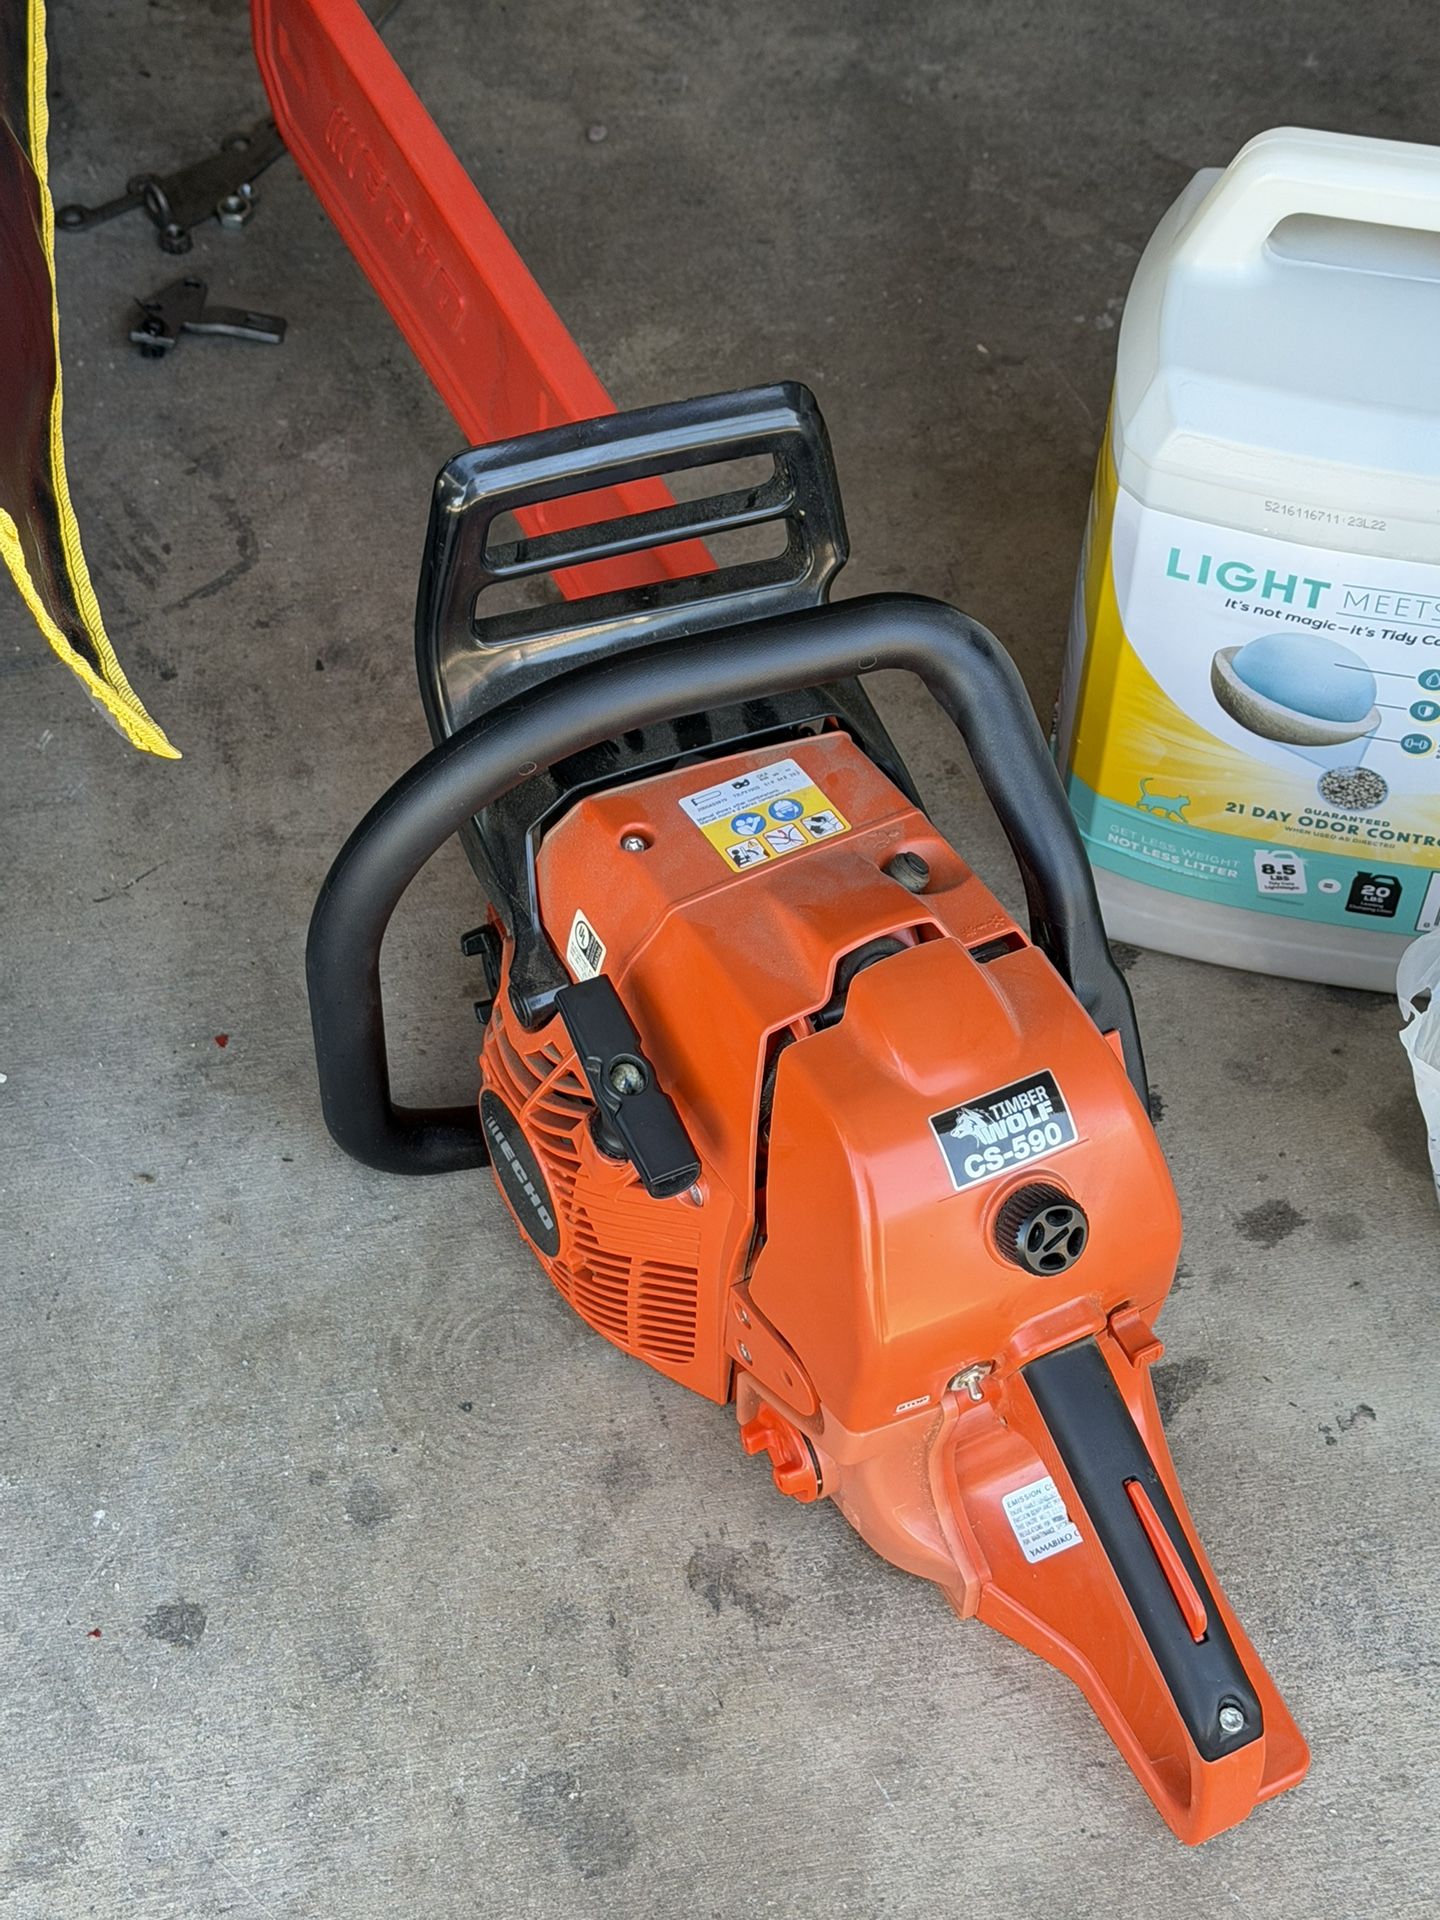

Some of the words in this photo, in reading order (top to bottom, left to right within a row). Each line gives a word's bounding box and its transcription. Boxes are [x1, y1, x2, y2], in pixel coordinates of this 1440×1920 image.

[1166, 547, 1332, 609] LIGHT
[1225, 598, 1250, 612] It's
[1253, 605, 1282, 619] not
[1381, 629, 1418, 646] Tidy
[1225, 801, 1245, 814] 21
[1251, 806, 1292, 823] DAY
[1298, 815, 1359, 836] ODOR
[1366, 828, 1440, 847] CONTR
[1285, 826, 1311, 835] WHEN
[1313, 831, 1337, 840] USED
[1352, 837, 1396, 849] DIRECTED
[1304, 807, 1390, 828] GUARANTEED
[1107, 833, 1140, 851] NOT
[1143, 846, 1180, 865] LESS
[1183, 858, 1239, 879] LITTER
[1110, 824, 1137, 839] GET
[1141, 835, 1178, 853] LESS
[1181, 847, 1241, 868] WEIGHT
[1261, 863, 1296, 876] 8.5
[1361, 884, 1391, 898] 20
[1364, 895, 1384, 903] LBS
[977, 1100, 1054, 1145] WOLF
[989, 1085, 1049, 1121] TIMBER
[964, 1122, 1062, 1179] CS-590
[499, 1139, 554, 1231] ECHO
[1006, 1487, 1042, 1508] EMISSION
[1029, 1532, 1073, 1557] YAMABIKO
